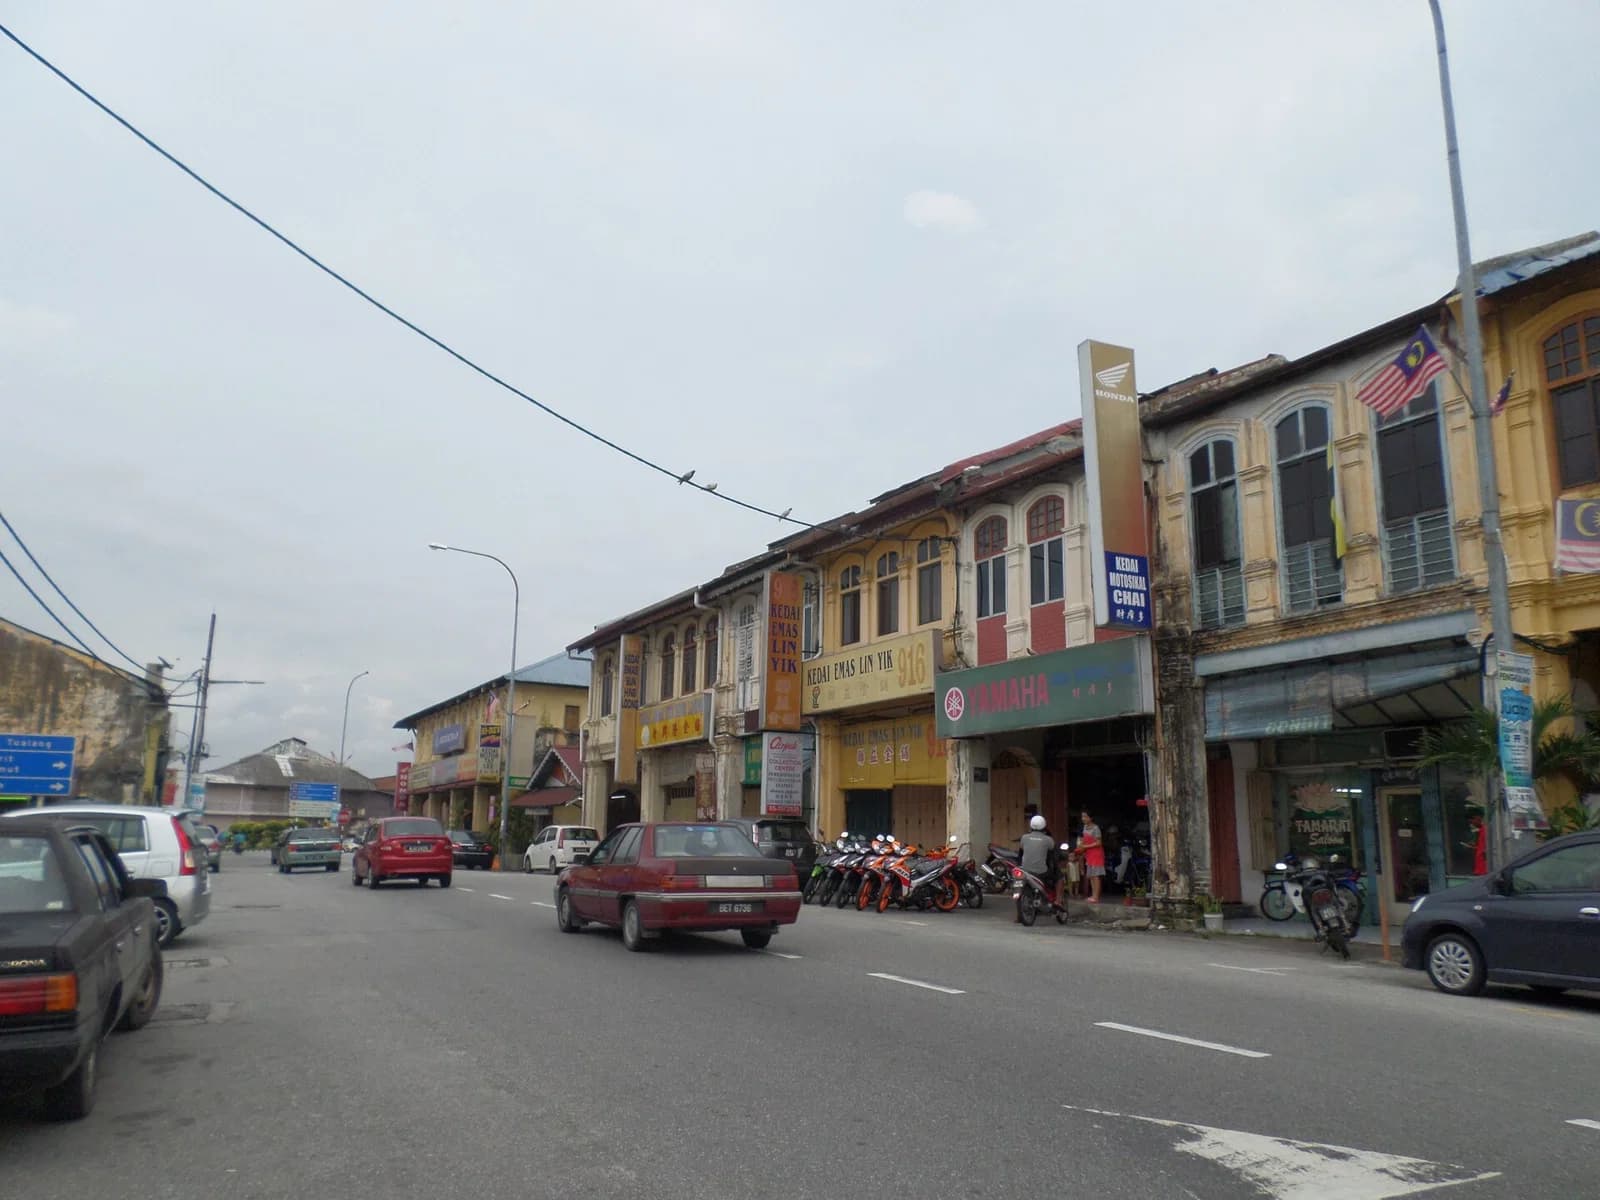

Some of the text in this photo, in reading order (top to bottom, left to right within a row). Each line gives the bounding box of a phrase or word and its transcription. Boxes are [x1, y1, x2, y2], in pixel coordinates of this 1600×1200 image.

[1095, 389, 1135, 404] HONDA
[1115, 556, 1138, 573] KEDAI
[1109, 572, 1147, 591] MOTOSIKAL
[1113, 589, 1146, 607] CHAI
[769, 604, 800, 620] KEDAI
[771, 621, 799, 639] EMAS
[771, 640, 797, 655] LIN
[770, 658, 798, 674] YIK
[807, 649, 894, 687] KEDAI EMAS LIN YIK
[897, 642, 926, 688] 916
[967, 672, 1050, 718] YAMAHA
[719, 903, 733, 913] BET
